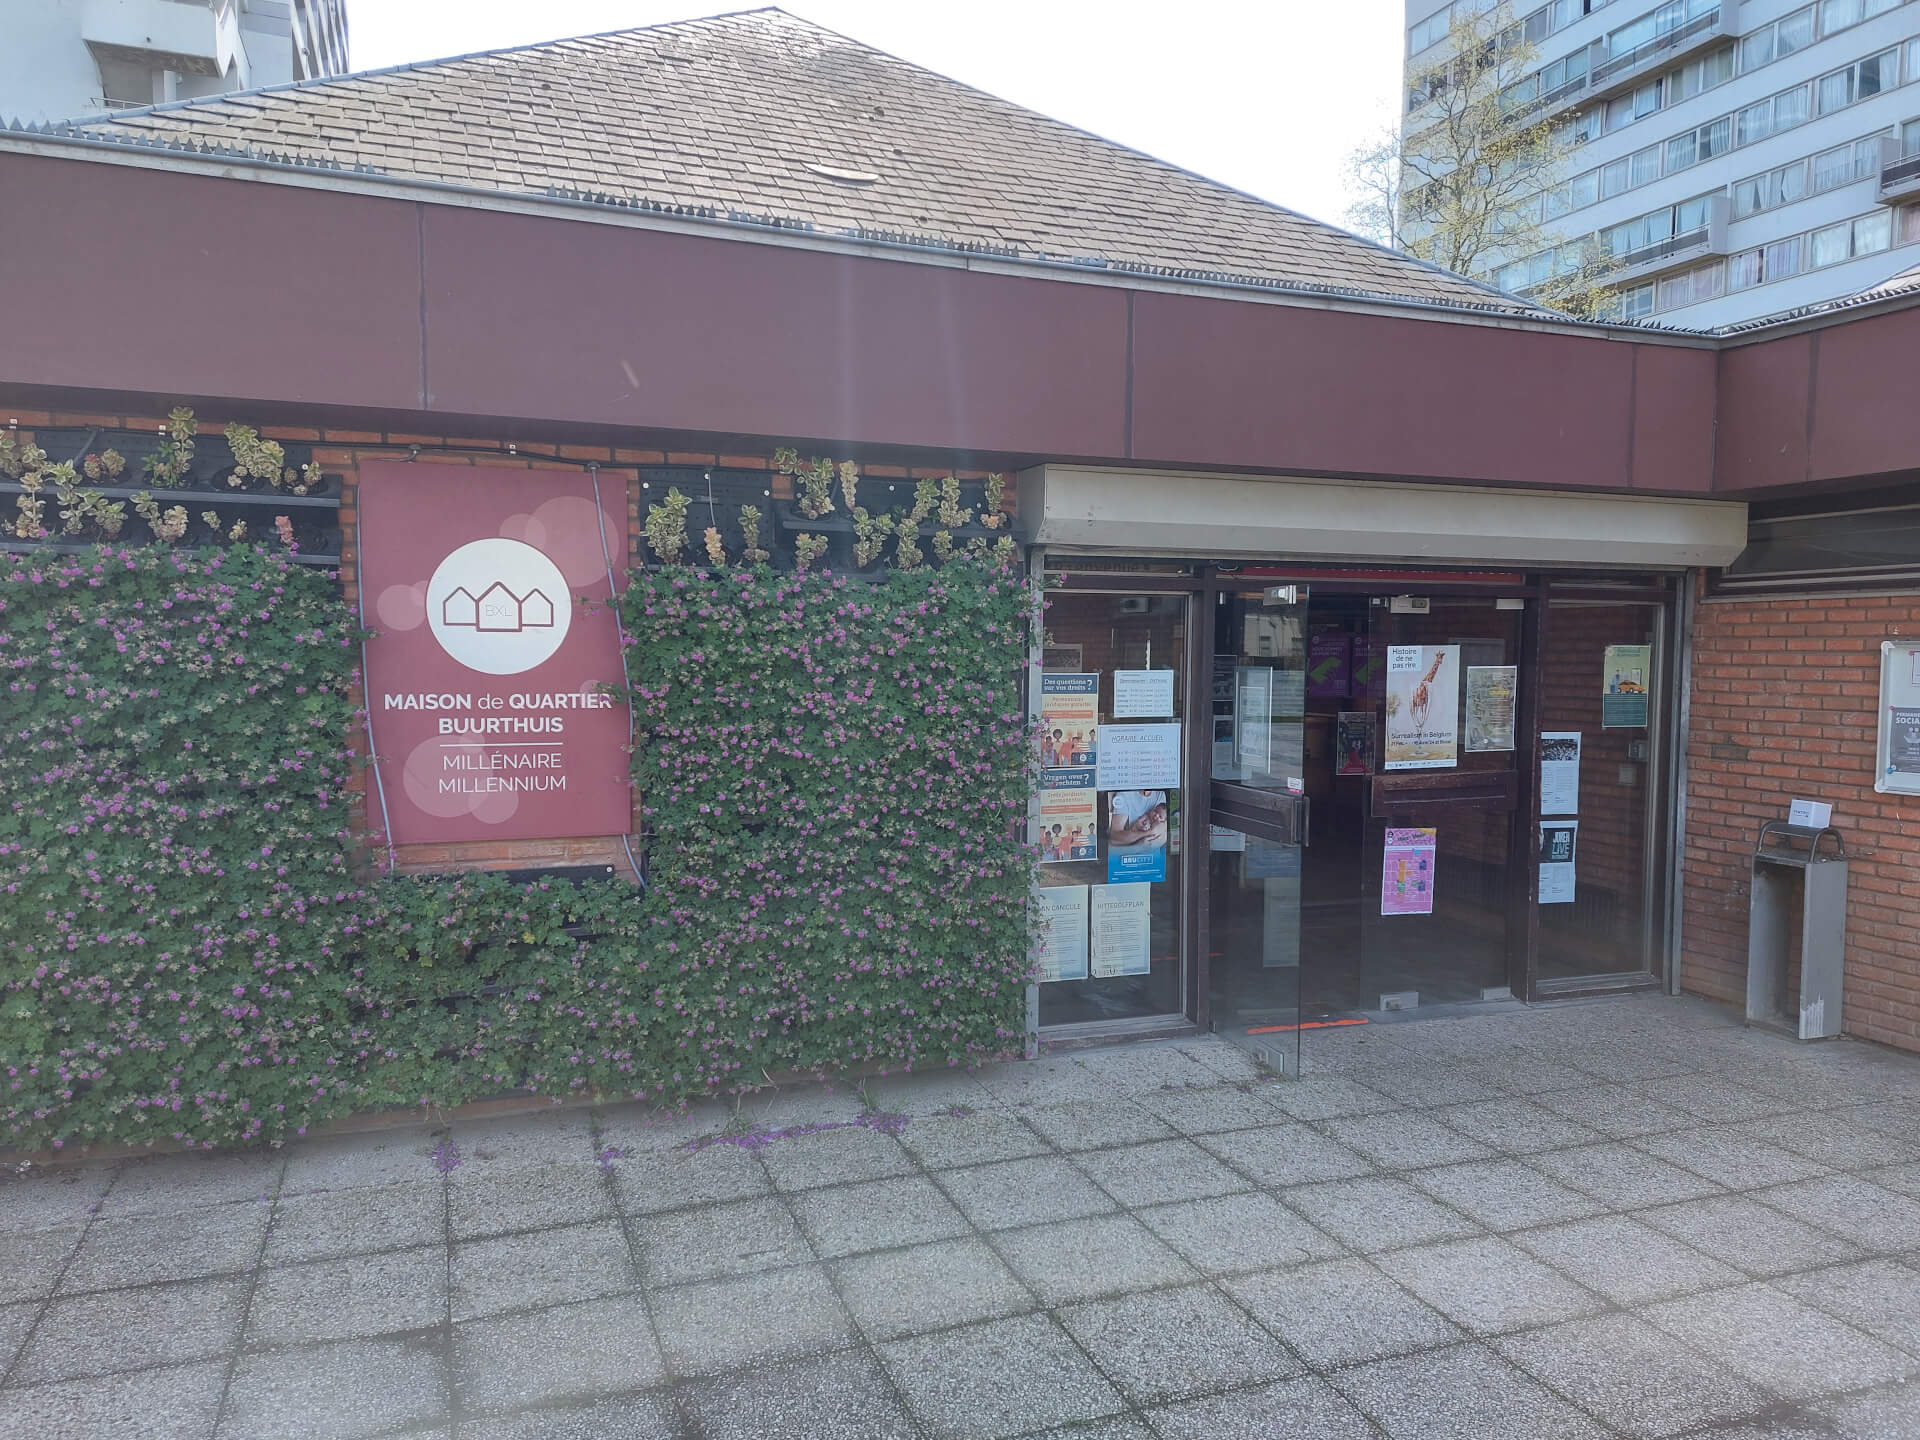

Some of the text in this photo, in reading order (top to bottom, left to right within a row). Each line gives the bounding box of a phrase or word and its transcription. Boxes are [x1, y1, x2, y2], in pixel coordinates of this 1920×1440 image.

[485, 605, 513, 617] BXL
[1056, 679, 1086, 687] questions
[384, 692, 612, 710] MAISON de QUARTIER
[439, 717, 564, 734] BUURTHUIS
[1429, 731, 1452, 739] Belgium
[443, 750, 562, 771] MILLÉNAIRE
[439, 775, 567, 794] MILLENNIUM
[1552, 842, 1570, 854] LIVE
